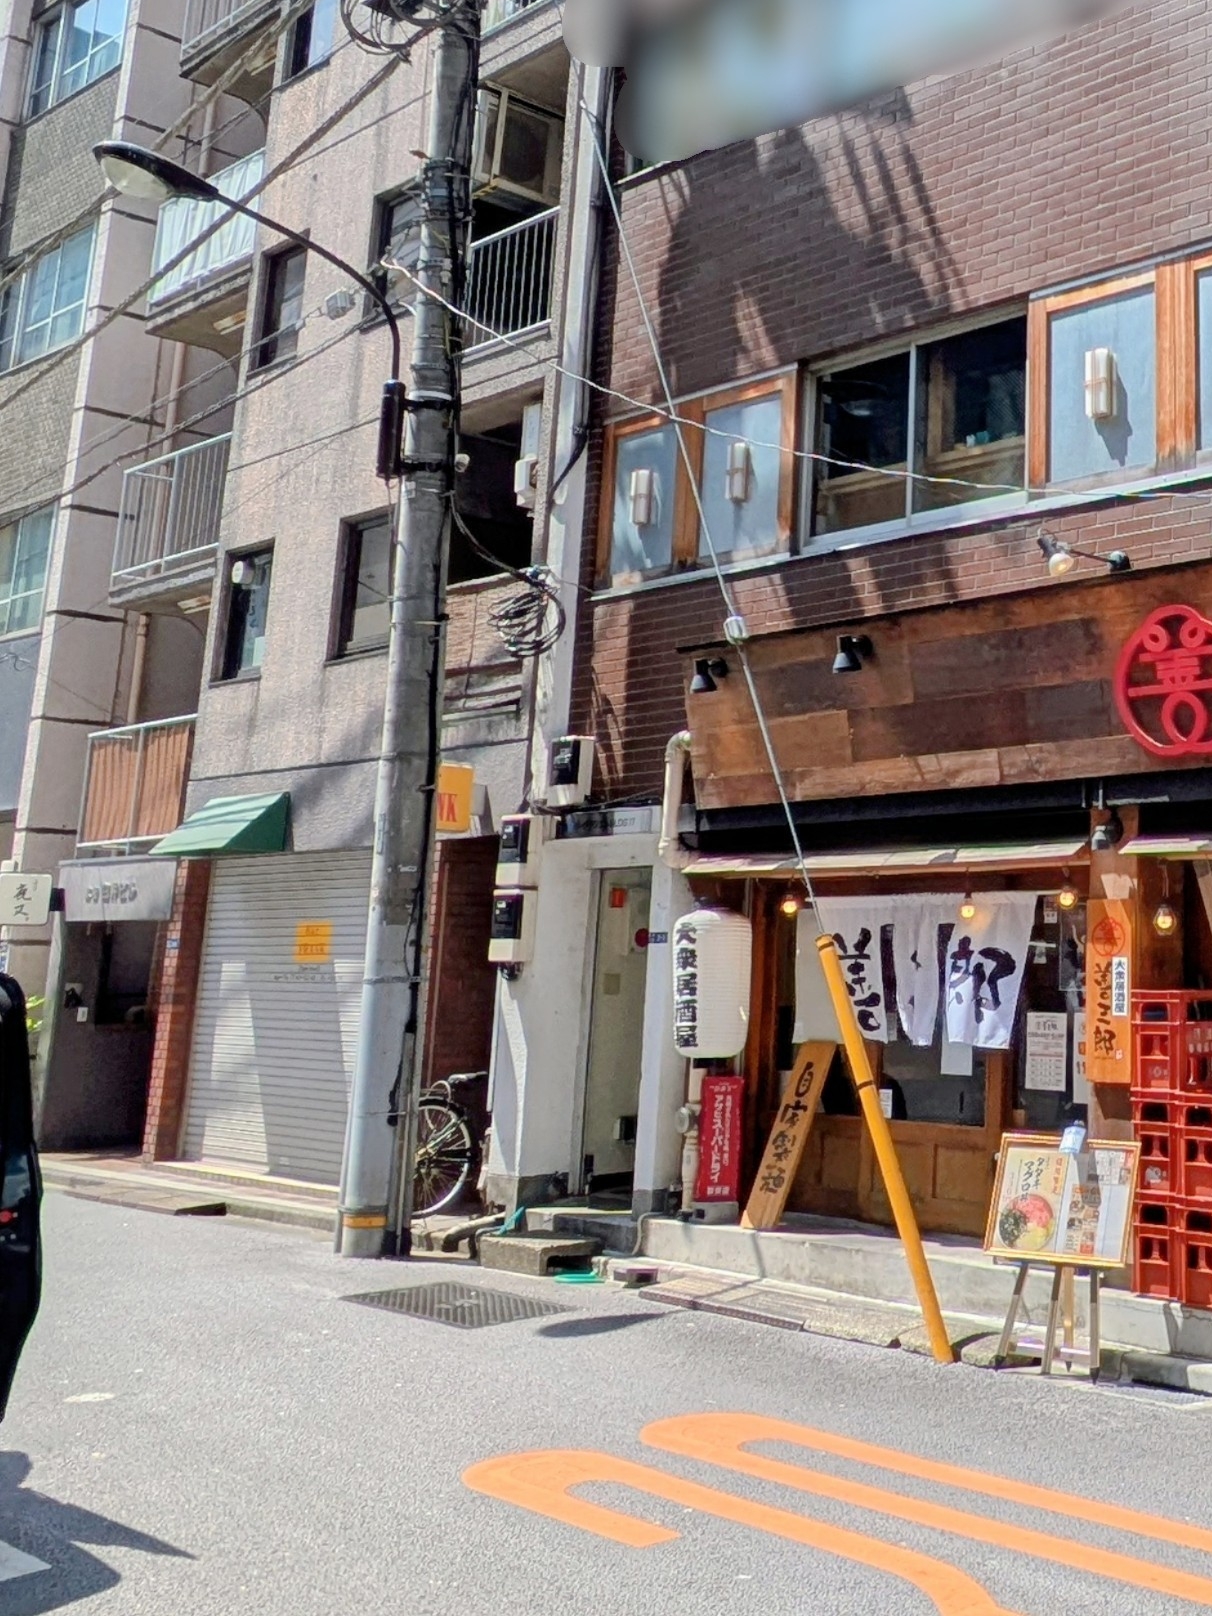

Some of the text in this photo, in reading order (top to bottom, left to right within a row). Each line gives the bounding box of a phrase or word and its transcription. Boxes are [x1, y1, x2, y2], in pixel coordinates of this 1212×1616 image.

[676, 922, 698, 1048] 大衆居酒屋
